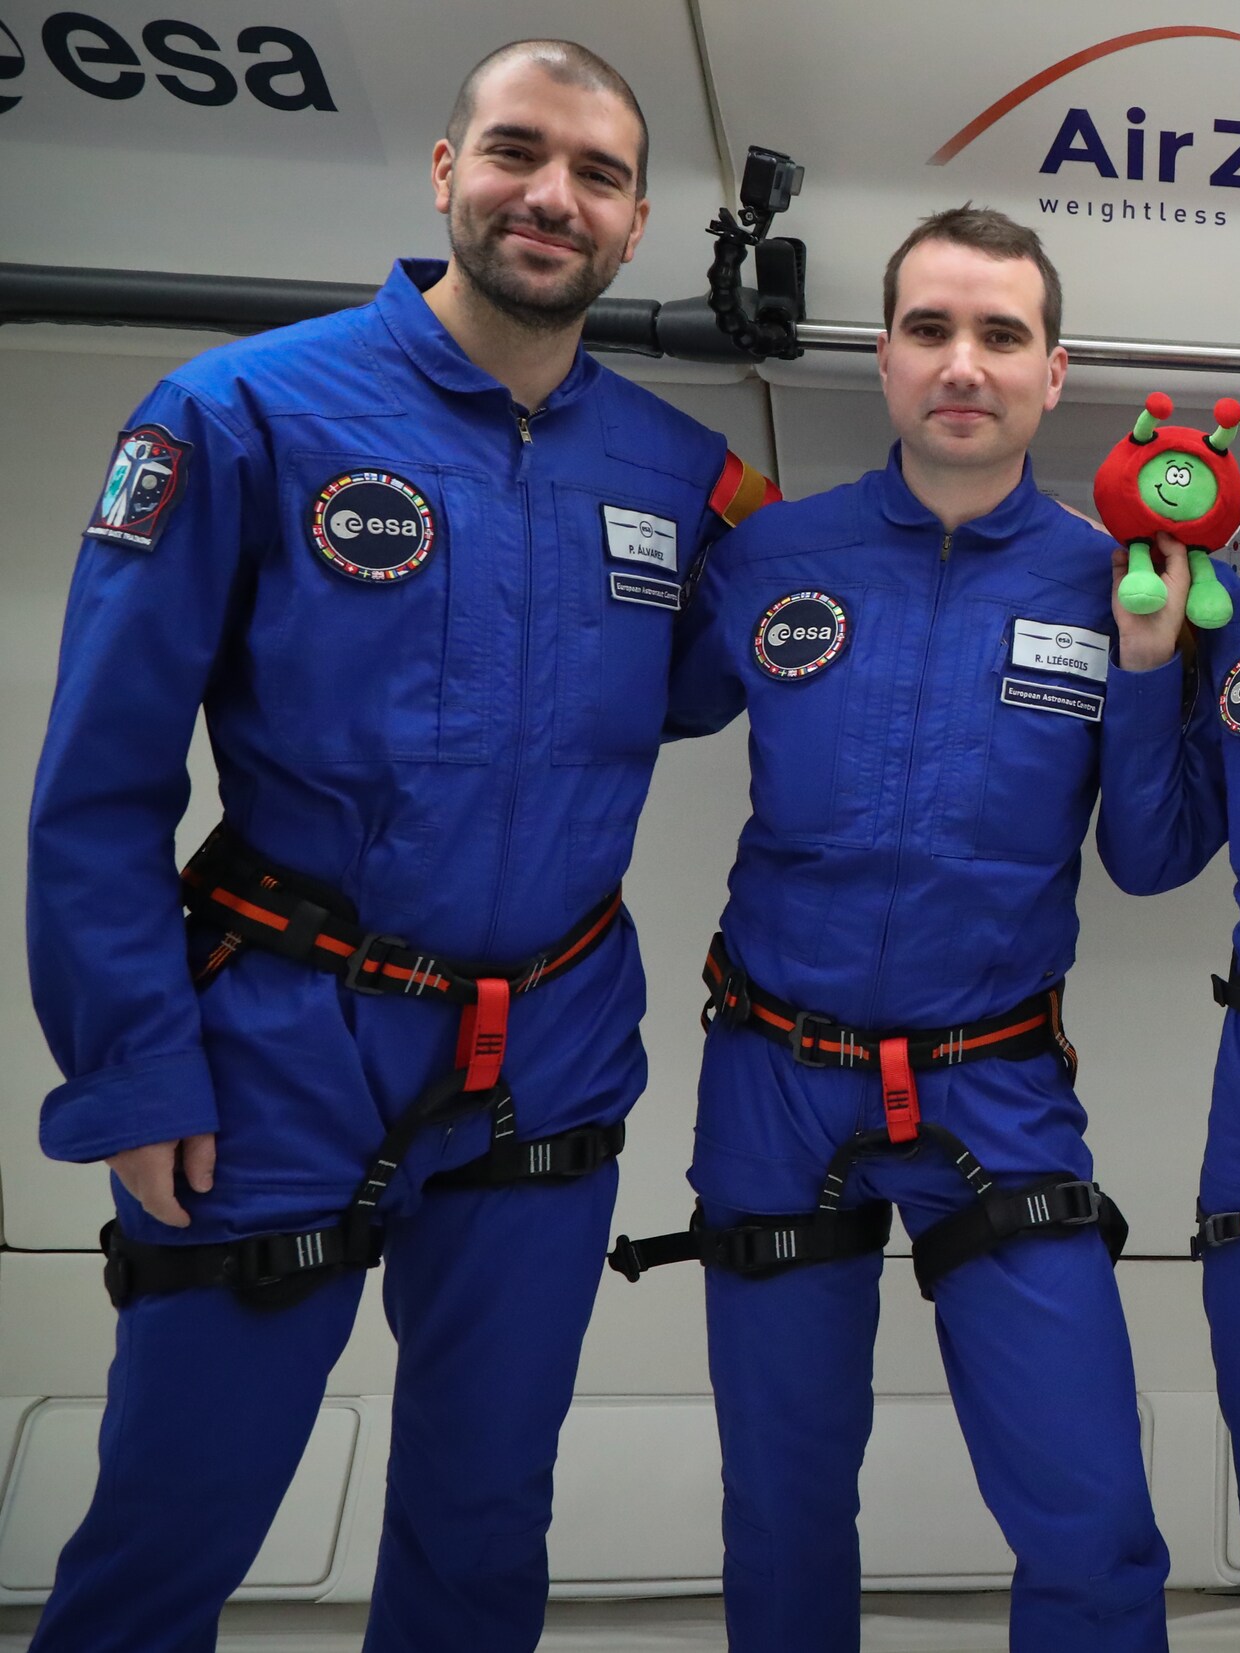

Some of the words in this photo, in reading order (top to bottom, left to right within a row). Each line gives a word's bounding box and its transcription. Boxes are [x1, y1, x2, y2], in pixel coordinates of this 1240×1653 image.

[42, 11, 339, 112] esa
[1038, 197, 1228, 226] weightless
[366, 517, 418, 537] esa
[793, 626, 832, 640] esa
[1034, 654, 1044, 663] R.
[1046, 655, 1088, 671] LIÉGEOIS
[1008, 687, 1041, 699] European
[1042, 693, 1077, 707] Astronaut
